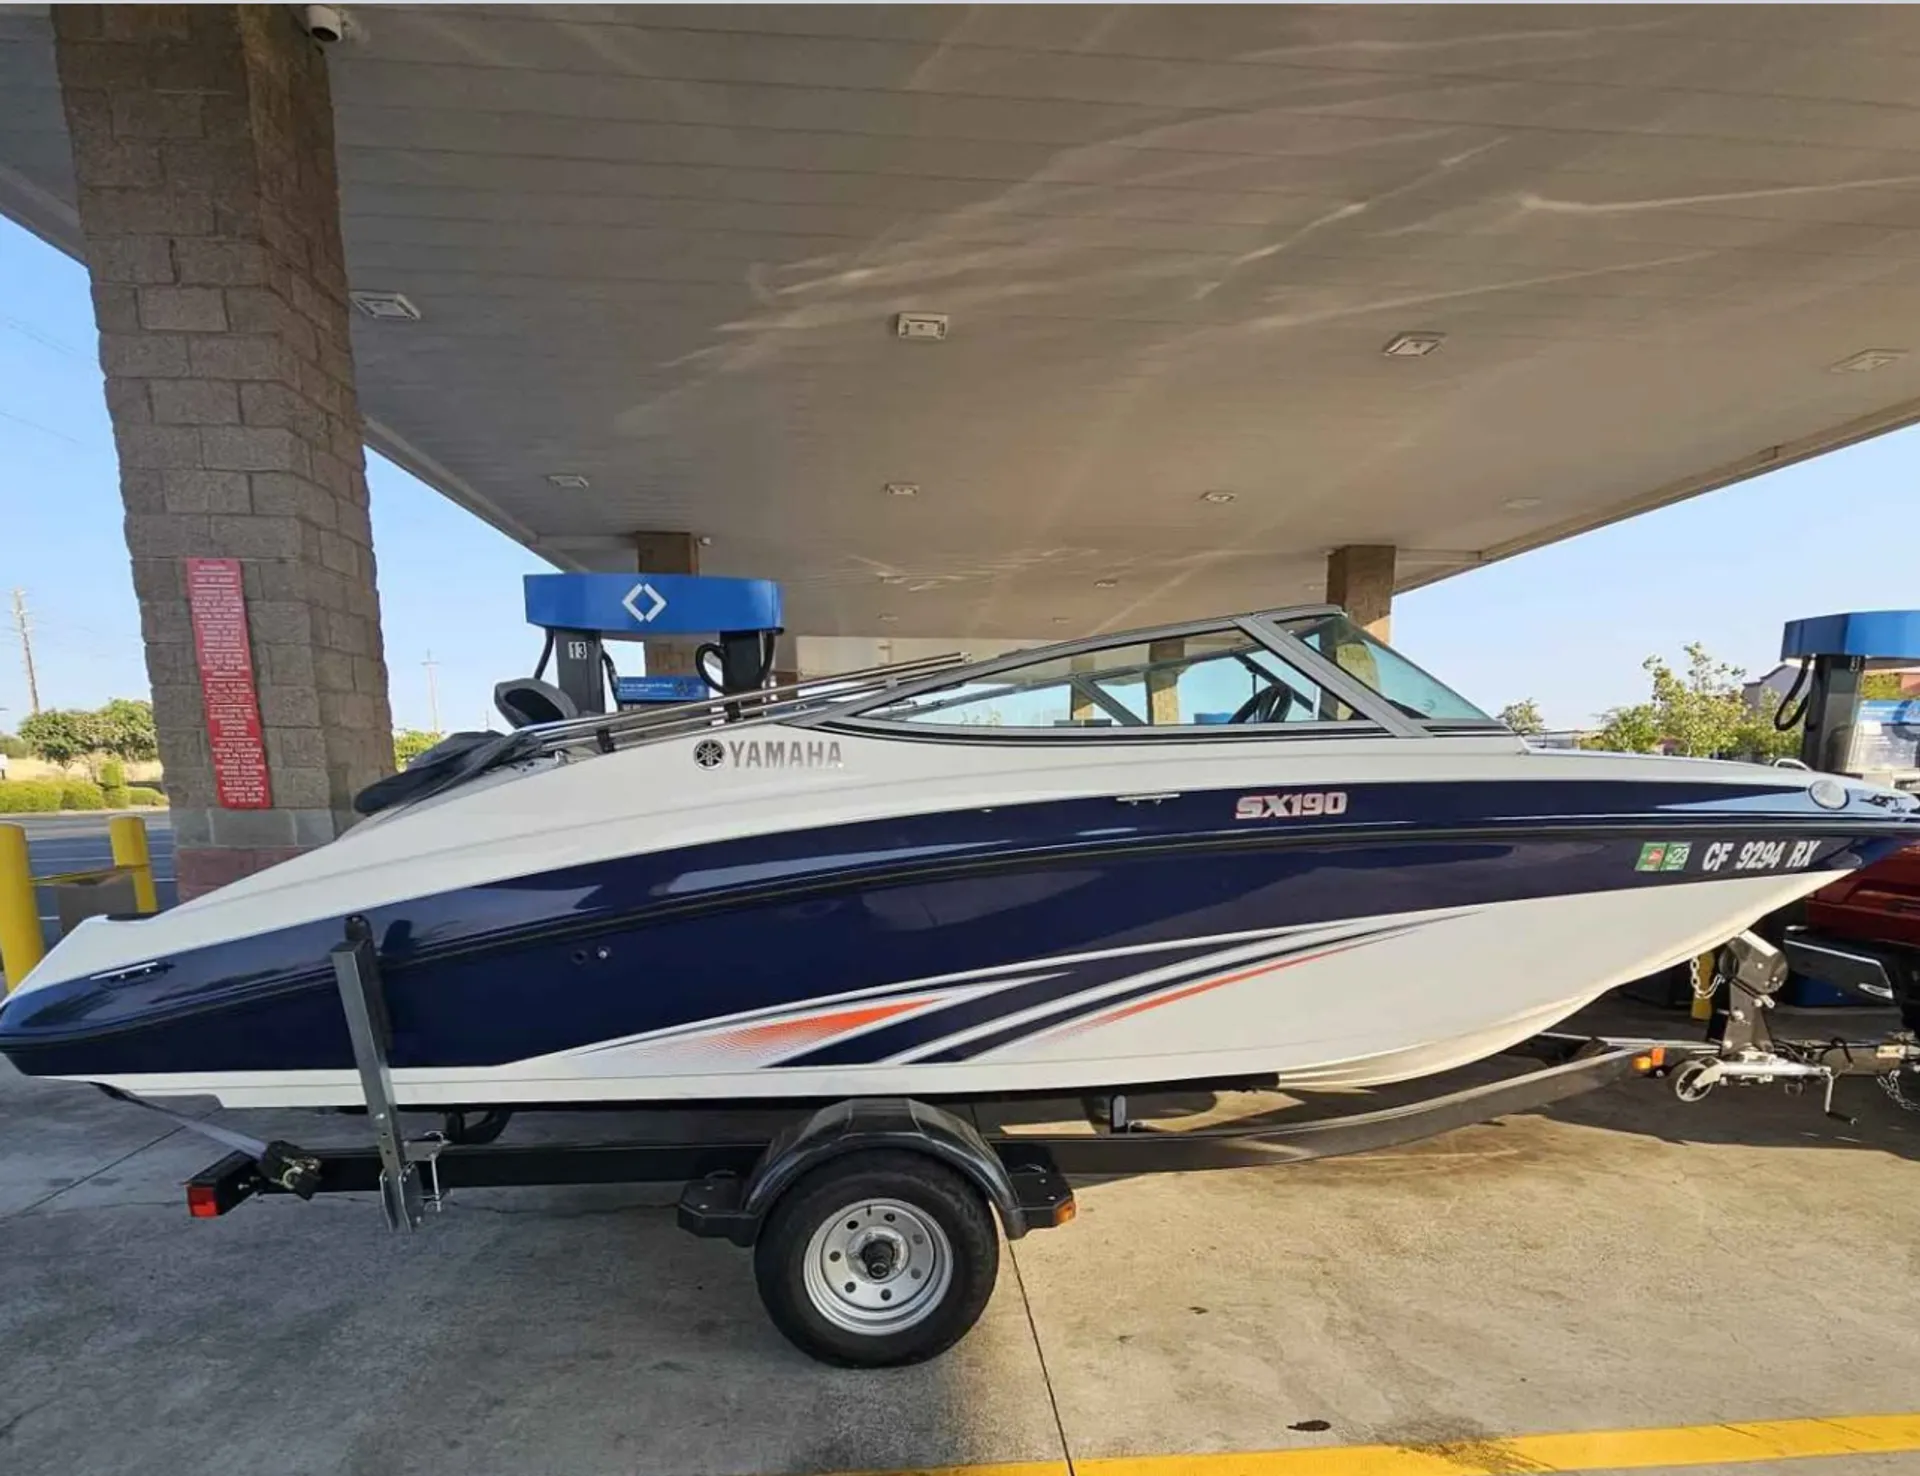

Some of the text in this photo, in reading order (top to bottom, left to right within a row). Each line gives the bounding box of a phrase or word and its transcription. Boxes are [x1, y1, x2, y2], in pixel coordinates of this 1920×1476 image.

[570, 642, 586, 658] 13
[728, 740, 842, 768] YAMAHA
[1235, 792, 1348, 819] SX190
[1702, 840, 1822, 871] CF 9294 RX
